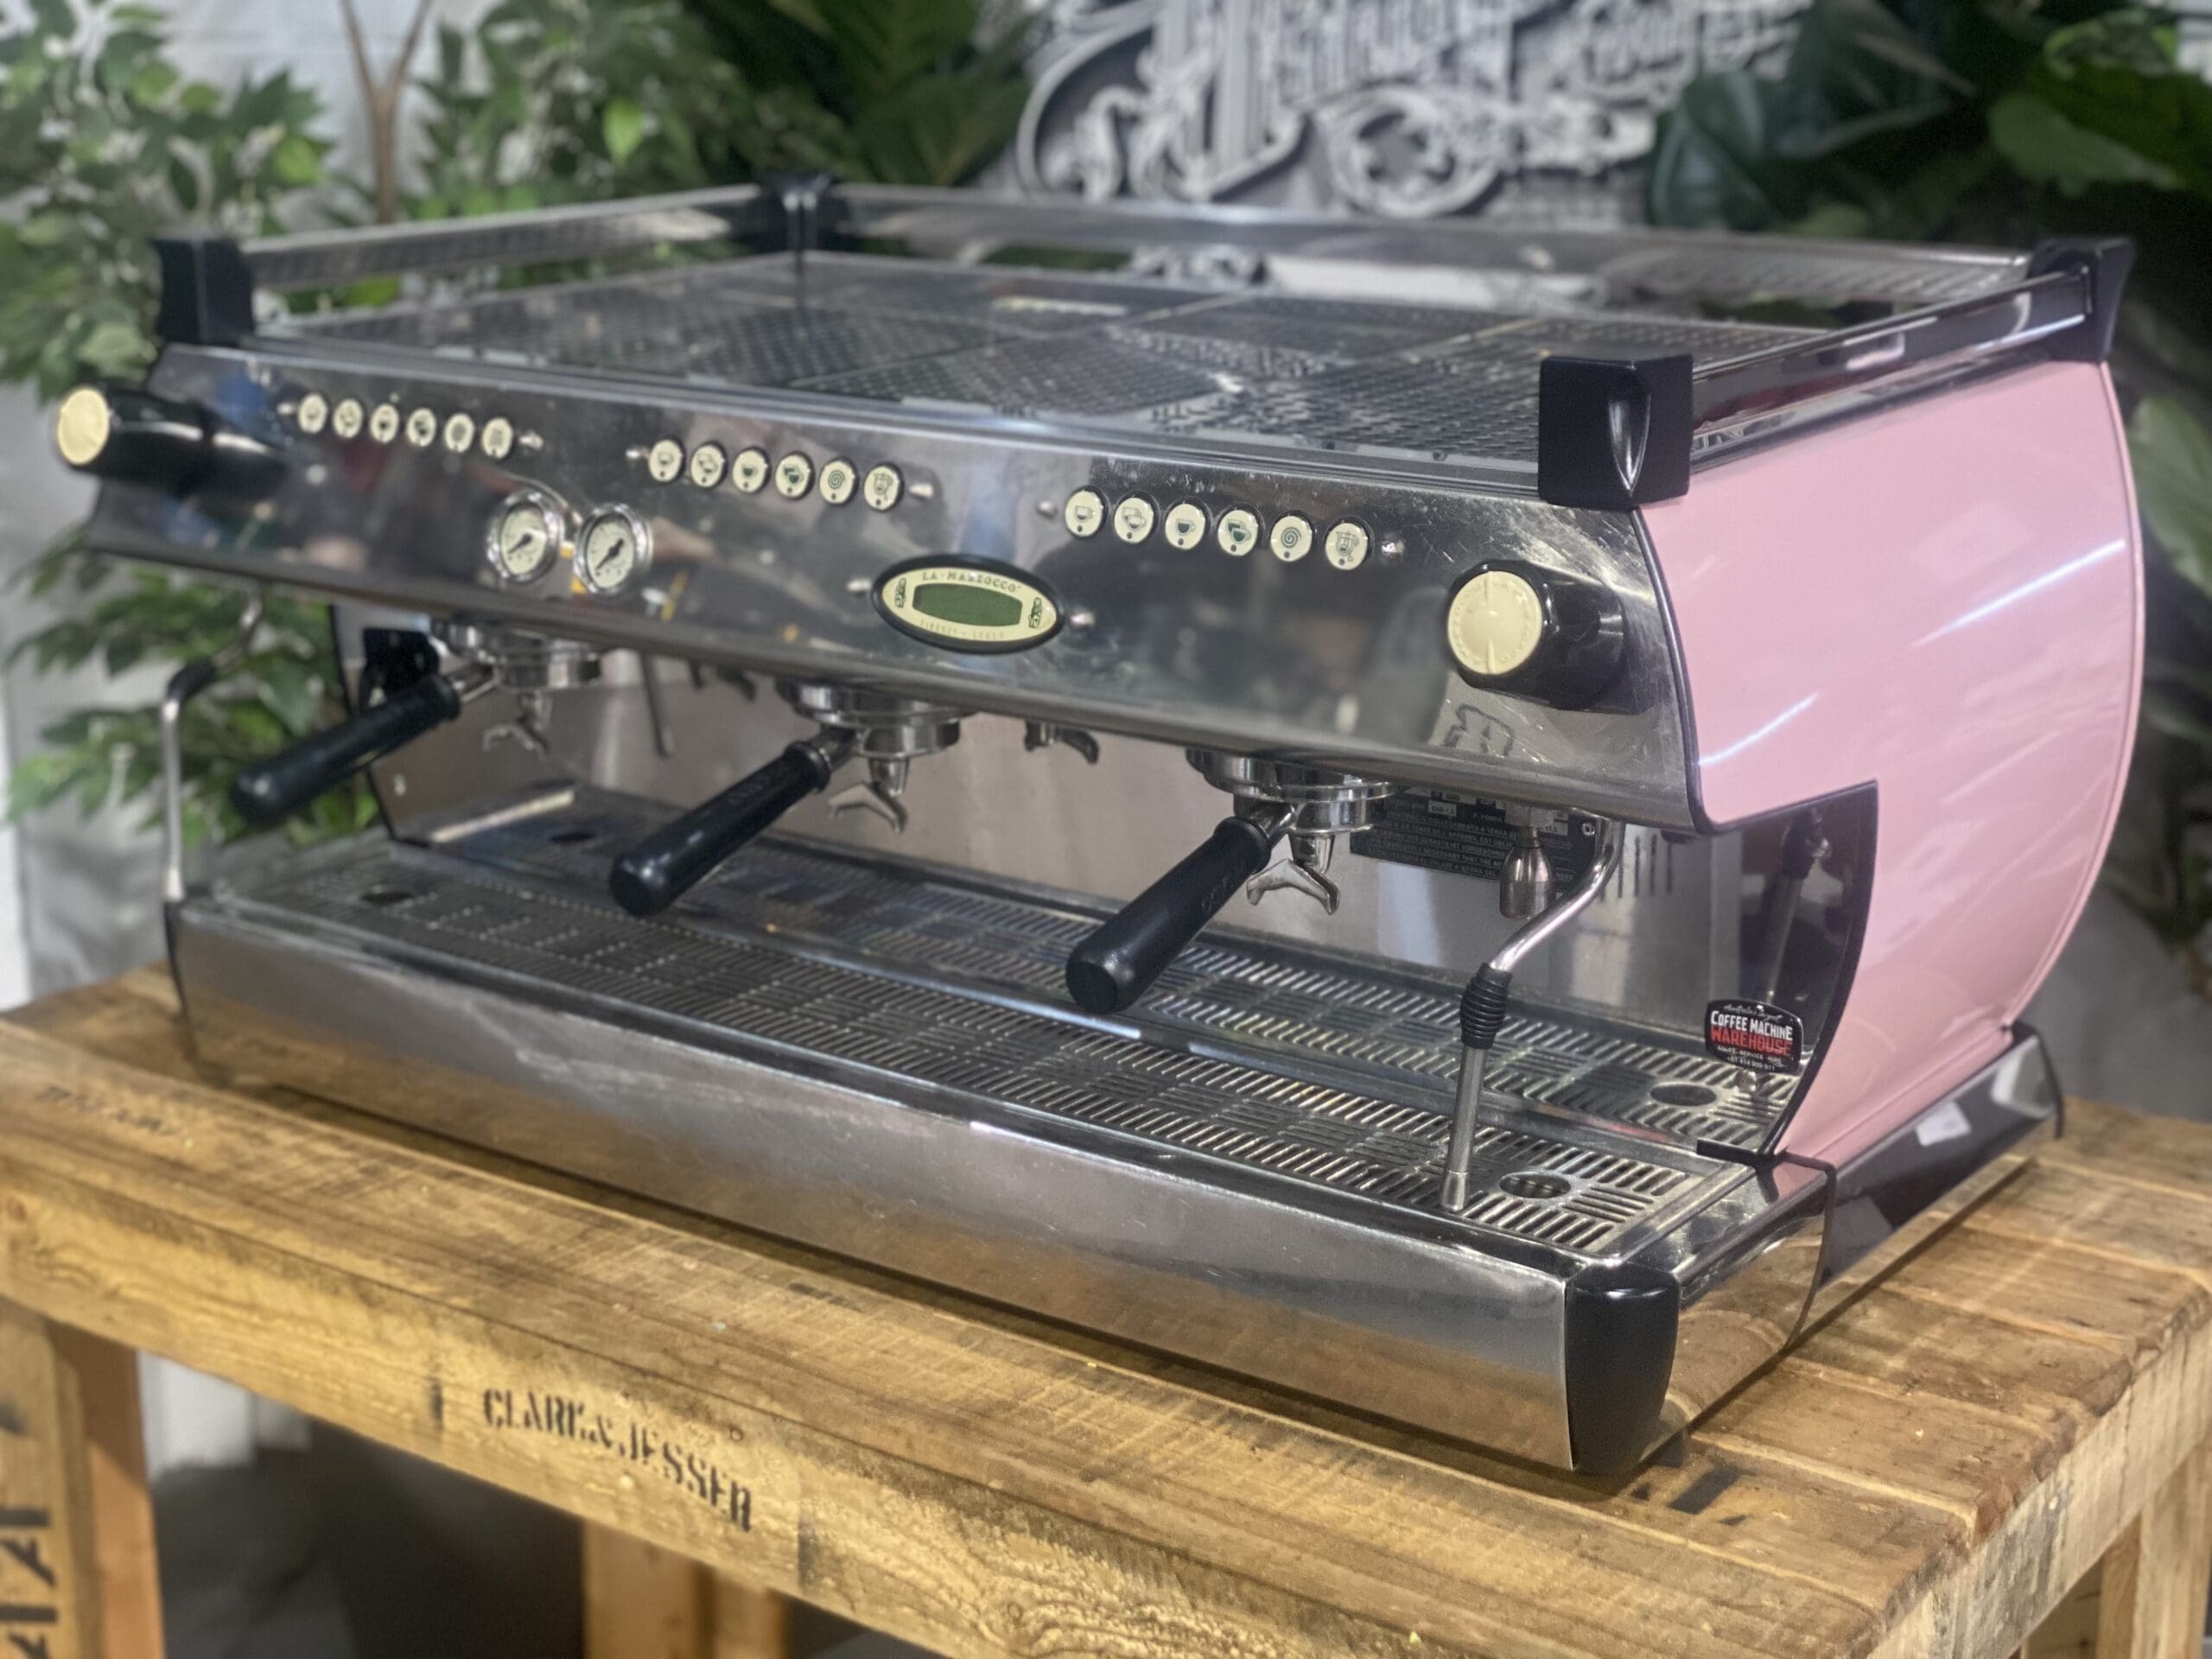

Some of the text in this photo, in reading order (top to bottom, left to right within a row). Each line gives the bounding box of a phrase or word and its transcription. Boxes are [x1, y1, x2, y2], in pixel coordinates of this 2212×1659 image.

[922, 572, 938, 581] LA
[1710, 1024, 1794, 1057] WAREHOUSE
[1711, 1010, 1793, 1041] COFFEE MACHINE
